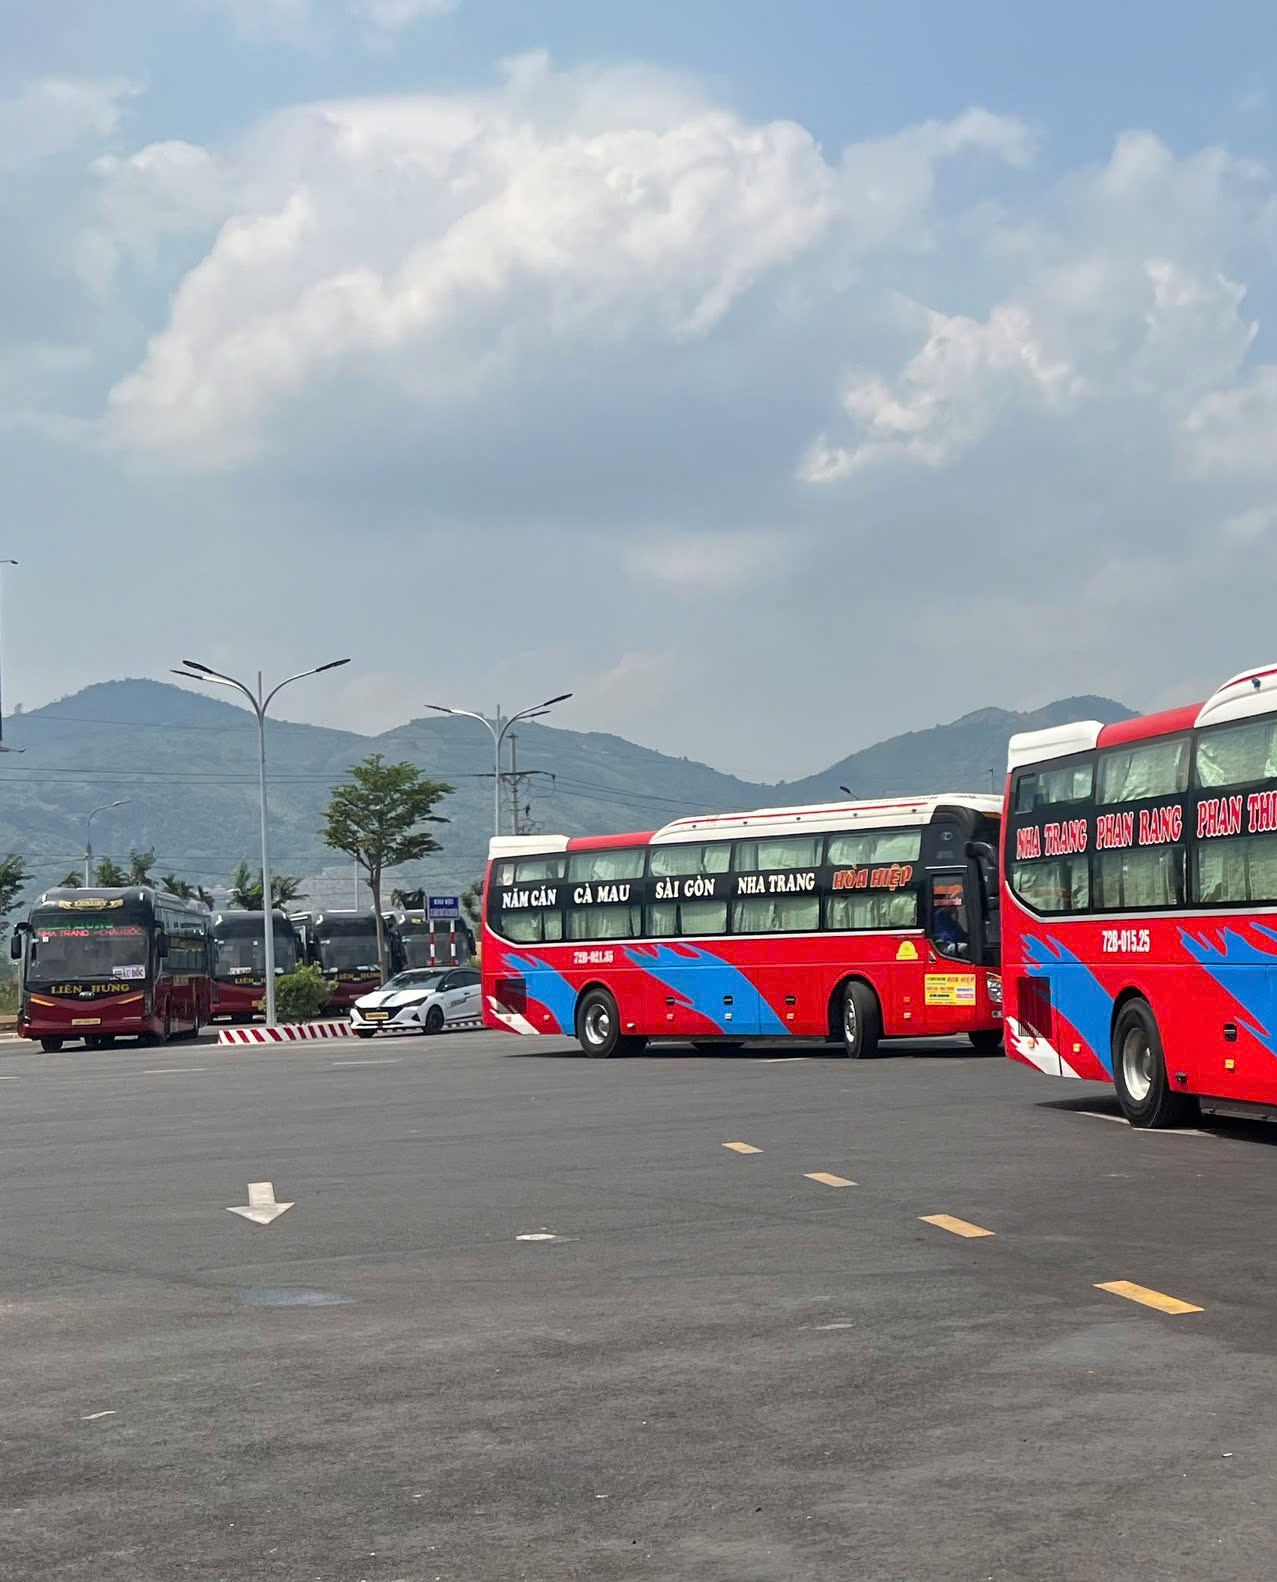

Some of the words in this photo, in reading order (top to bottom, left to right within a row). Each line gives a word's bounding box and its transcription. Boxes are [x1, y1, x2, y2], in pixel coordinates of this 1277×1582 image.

[1096, 811, 1135, 850] PHAN
[1139, 805, 1182, 846] RANG
[1197, 795, 1243, 838] PHAN
[1016, 828, 1041, 860] NHA
[1044, 818, 1088, 857] TRANG
[655, 877, 680, 900] SÀI
[684, 875, 716, 897] GÒN
[737, 875, 766, 895] NHA
[768, 872, 816, 892] TRANG
[832, 864, 869, 890] HÒA
[870, 863, 913, 892] HIỆP
[502, 887, 529, 909] NĂM
[530, 884, 557, 907] CĂN
[573, 883, 593, 904] CÀ
[597, 884, 631, 903] MAU
[1102, 929, 1150, 953] 72B-015.25
[51, 984, 82, 994] LIÊN
